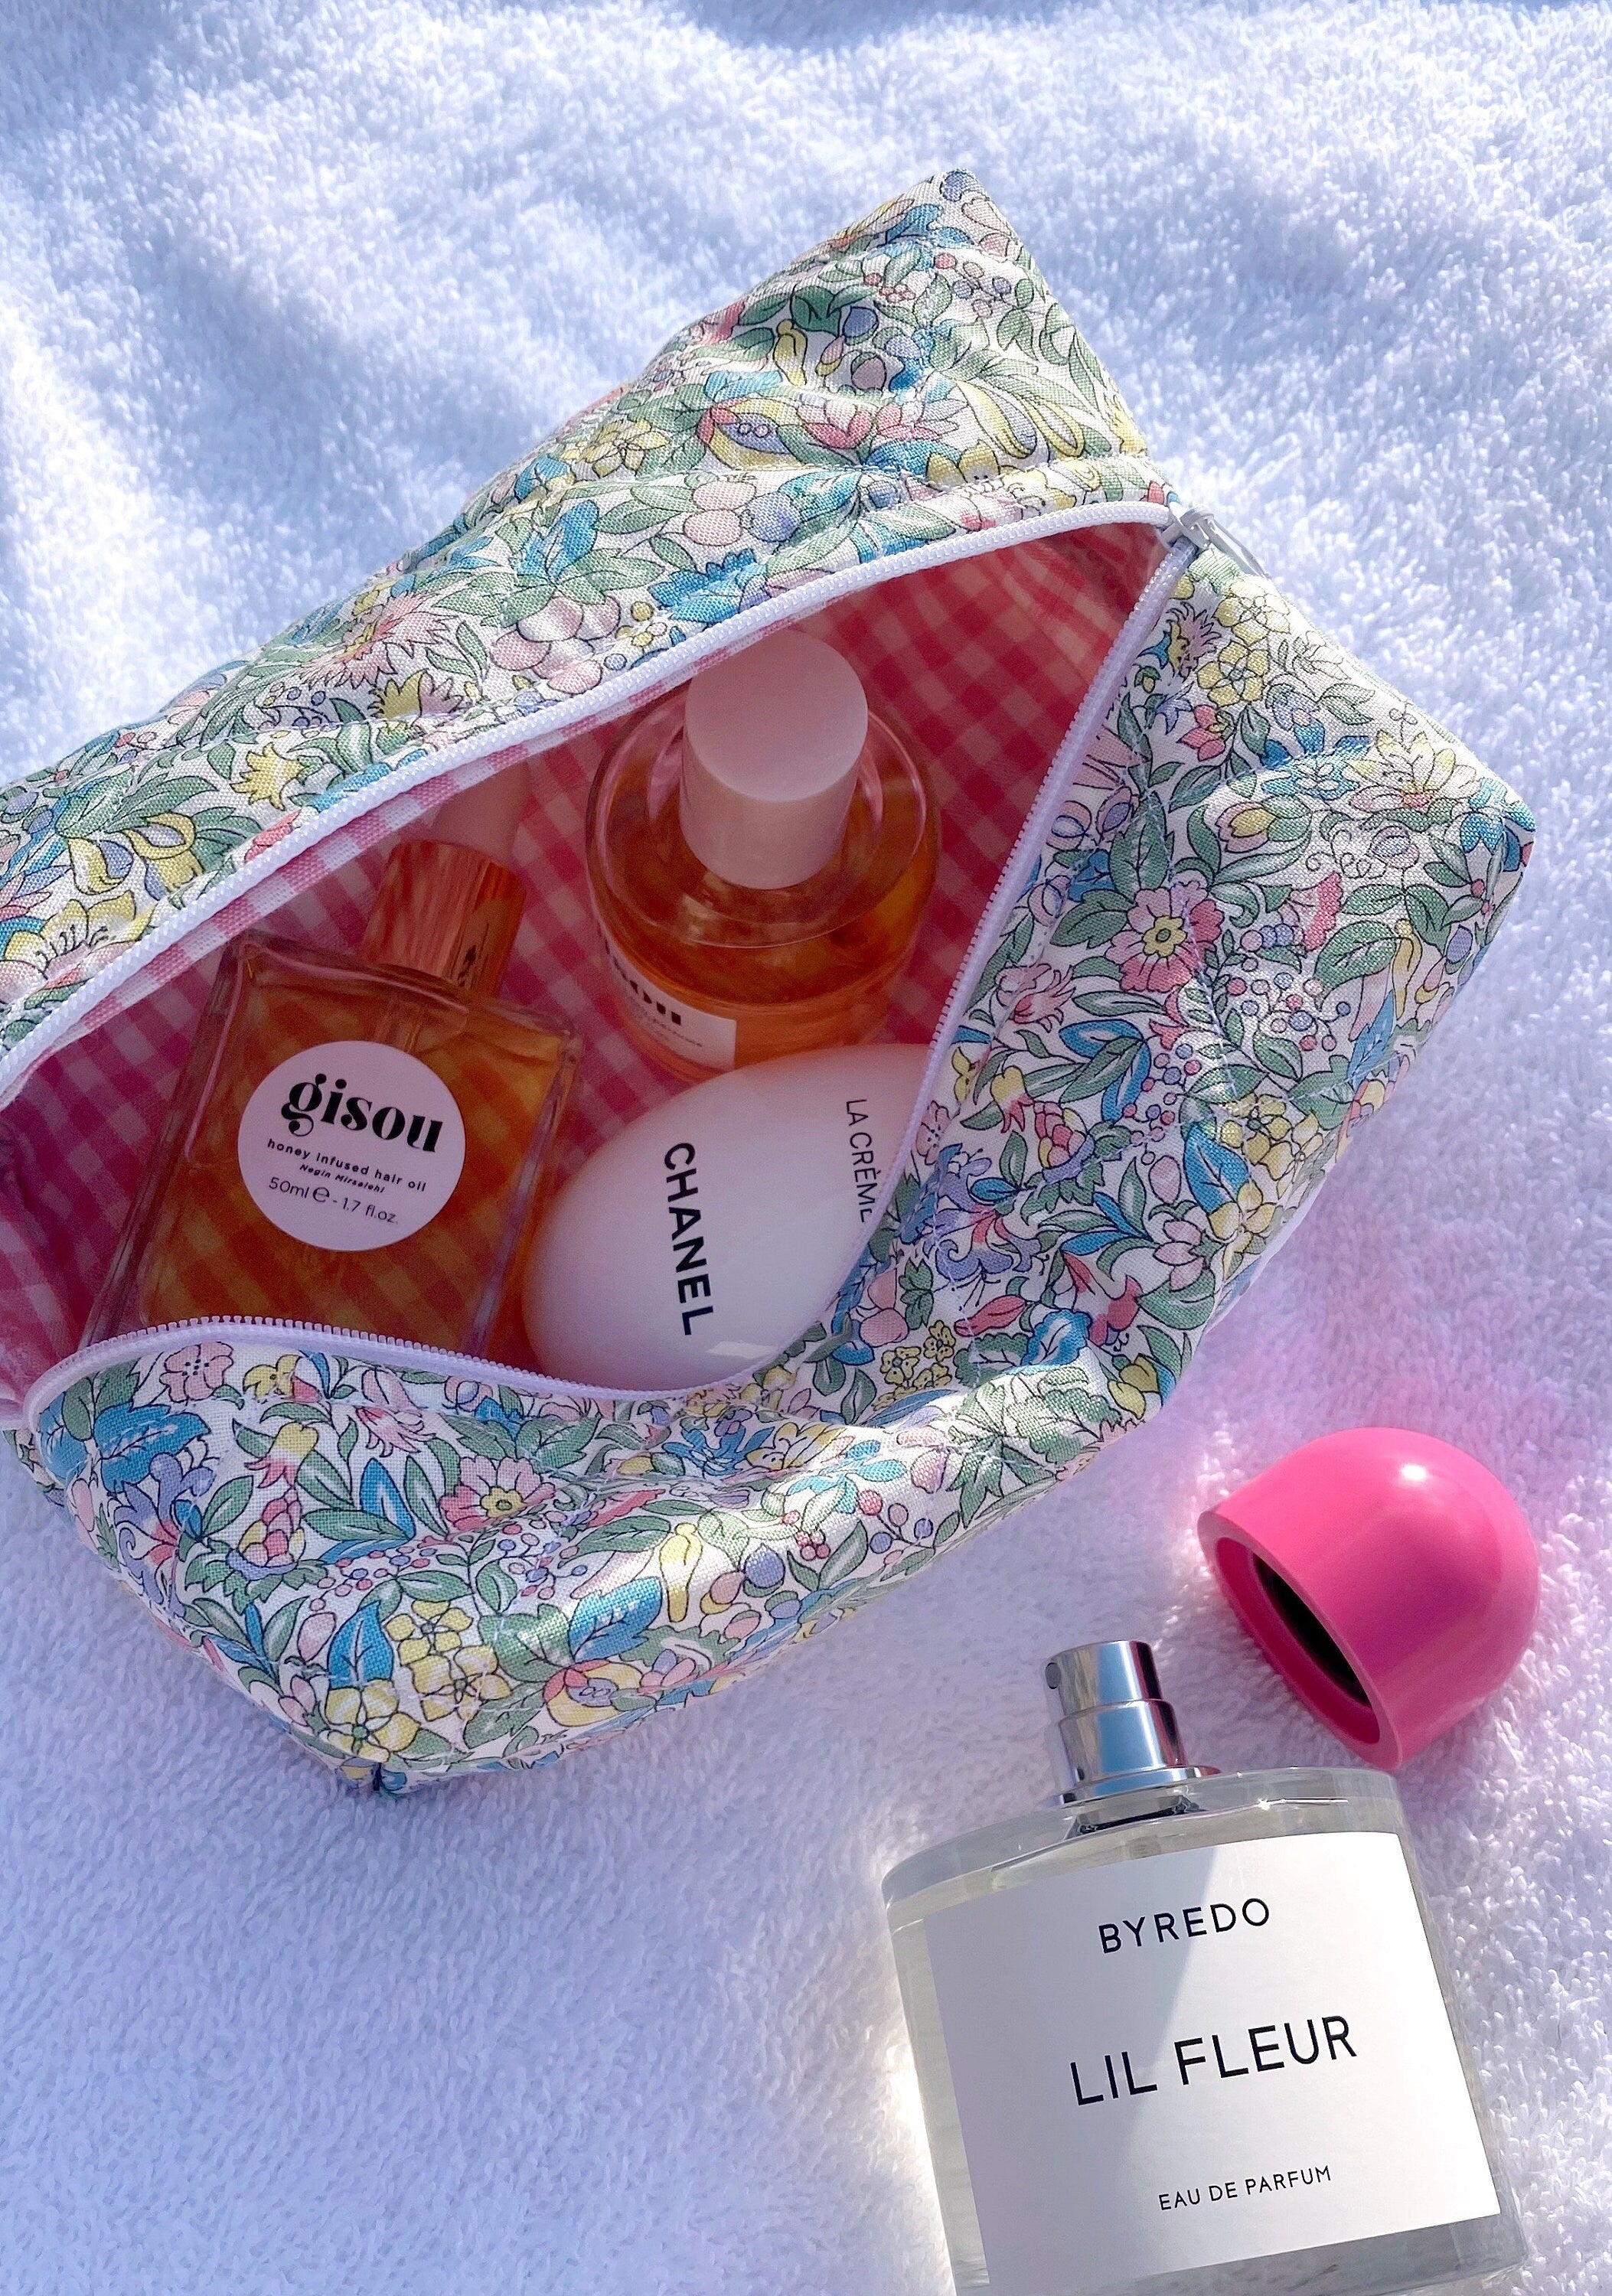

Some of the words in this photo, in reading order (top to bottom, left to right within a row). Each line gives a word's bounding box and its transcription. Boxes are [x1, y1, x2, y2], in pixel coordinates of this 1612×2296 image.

[281, 1073, 443, 1153] gisou
[845, 1098, 869, 1127] LA
[266, 1138, 311, 1160] honey
[315, 1152, 370, 1176] infused
[374, 1169, 403, 1186] hair
[407, 1181, 427, 1192] oil
[299, 1162, 332, 1179] Negin
[342, 1197, 362, 1212] 1.7
[663, 1142, 714, 1336] CHANEL
[1098, 1897, 1270, 1955] BYREDO
[1069, 2050, 1158, 2106] LIL
[1173, 2014, 1358, 2086] FLEUR
[1158, 2187, 1202, 2211] EAU
[1208, 2181, 1238, 2202] DE
[1245, 2164, 1331, 2196] PARFUM
